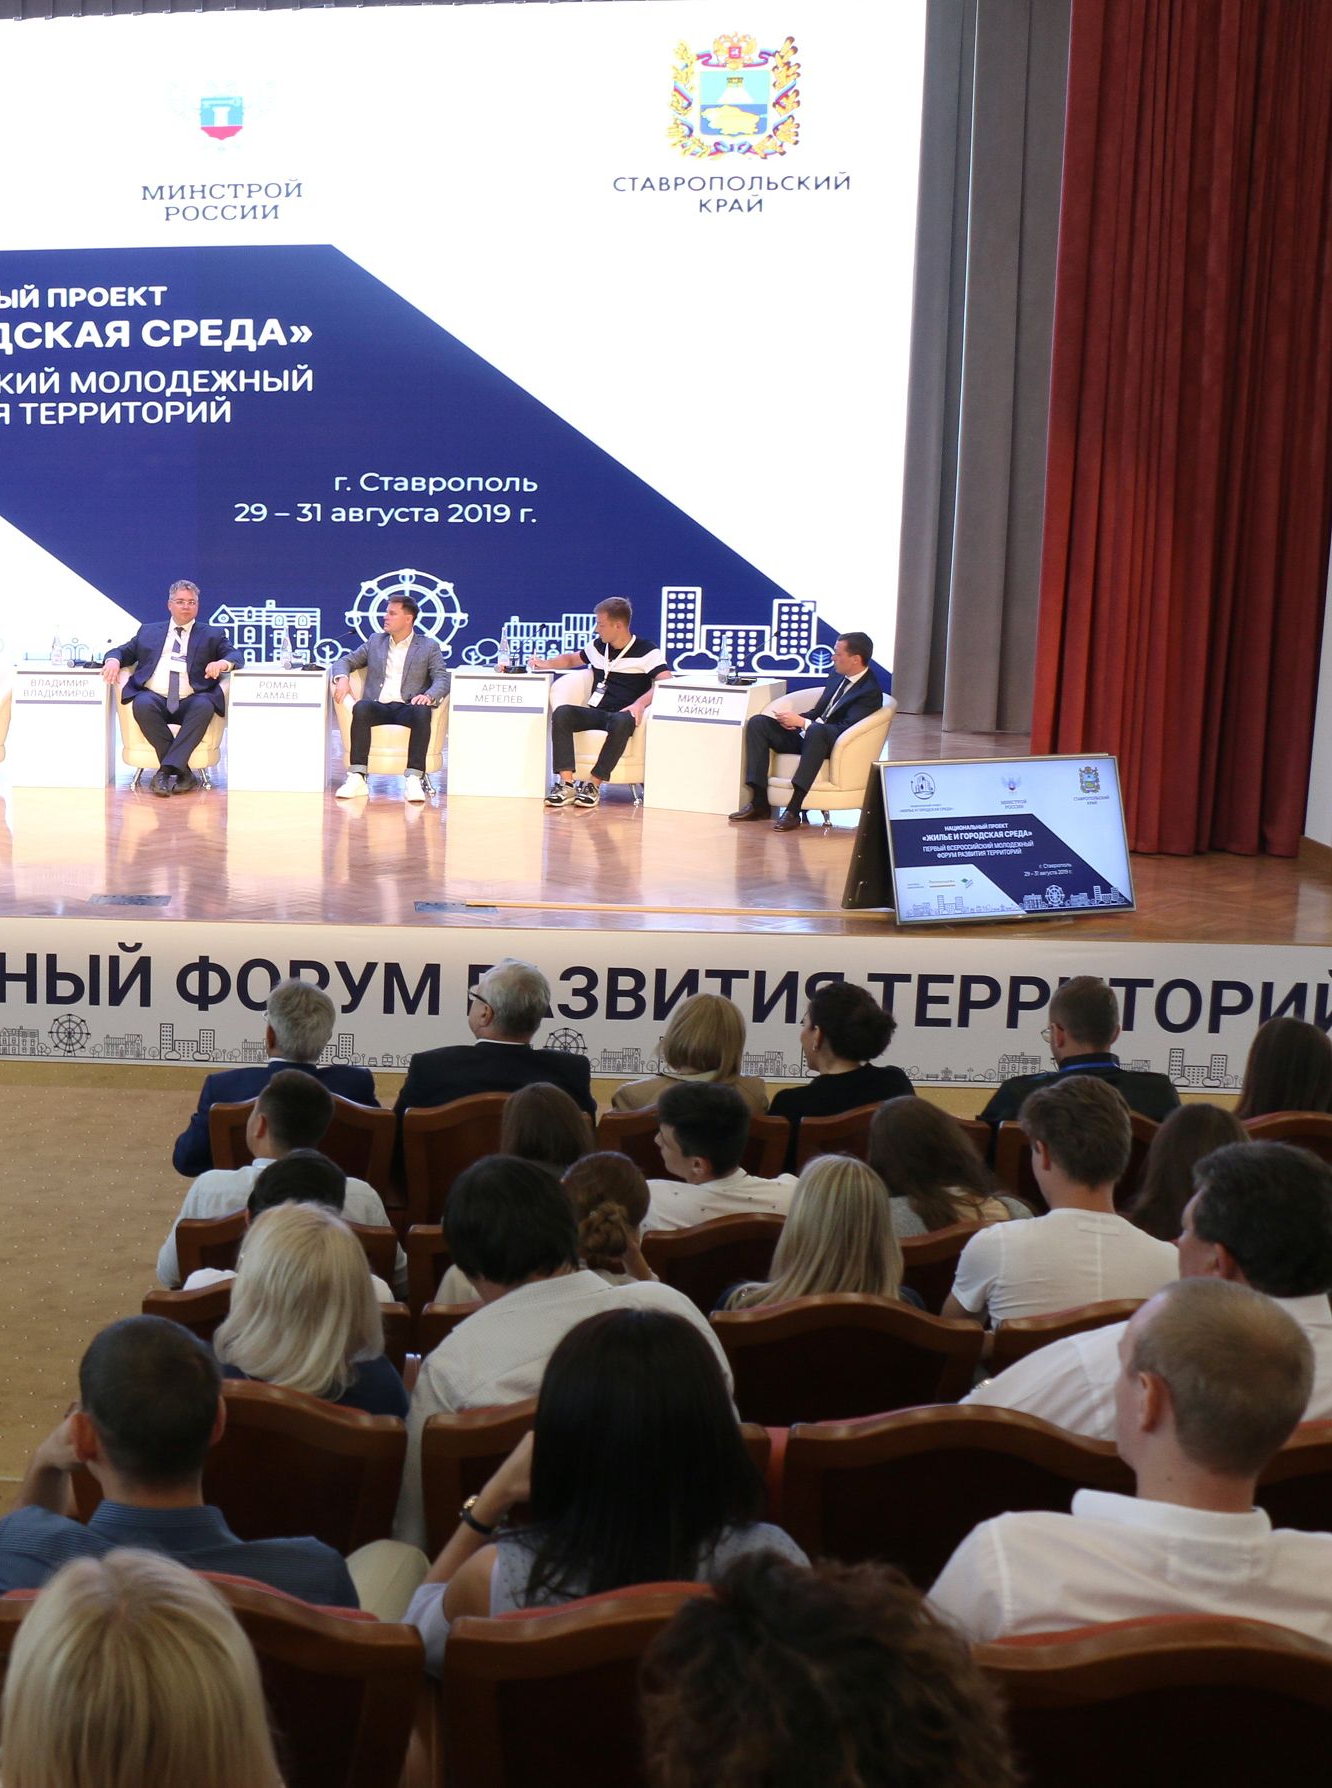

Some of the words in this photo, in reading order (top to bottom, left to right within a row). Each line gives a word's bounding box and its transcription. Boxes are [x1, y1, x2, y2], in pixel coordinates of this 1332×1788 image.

[141, 178, 303, 201] МИНСТРОЙ
[613, 171, 851, 192] СТАВРОПОЛЬСКИЙ
[699, 193, 763, 213] КРАЙ
[164, 204, 280, 222] РОССИИ
[47, 285, 168, 308] ПРОЕКТ
[141, 317, 314, 353] СРЕДА»
[70, 363, 314, 398] МОЛОДЕЖНЫЙ
[18, 395, 232, 426] ТЕРРИТОРИЙ
[333, 475, 352, 492] г.
[359, 472, 539, 496] Ставрополь
[233, 503, 268, 522] 29
[296, 503, 323, 522] 31
[330, 505, 440, 527] августа
[447, 503, 512, 523] 2019
[520, 507, 537, 523] г.
[30, 679, 89, 688] ВЛАДИМИР
[259, 681, 297, 689] РОМАН
[482, 684, 517, 693] АРТЕМ
[23, 689, 95, 698] ВЛАДИМИРОВ
[256, 691, 299, 699] КАМАЕВ
[474, 694, 523, 703] МЕТЕЛЕВ
[677, 694, 724, 705] МИХАИЛ
[676, 703, 720, 716] ХАЙКИН
[960, 831, 1004, 840] ГОРОДСКАЯ
[467, 964, 845, 1024] ЗВИТИ
[867, 968, 1332, 1034] ТЕРРТОРИ
